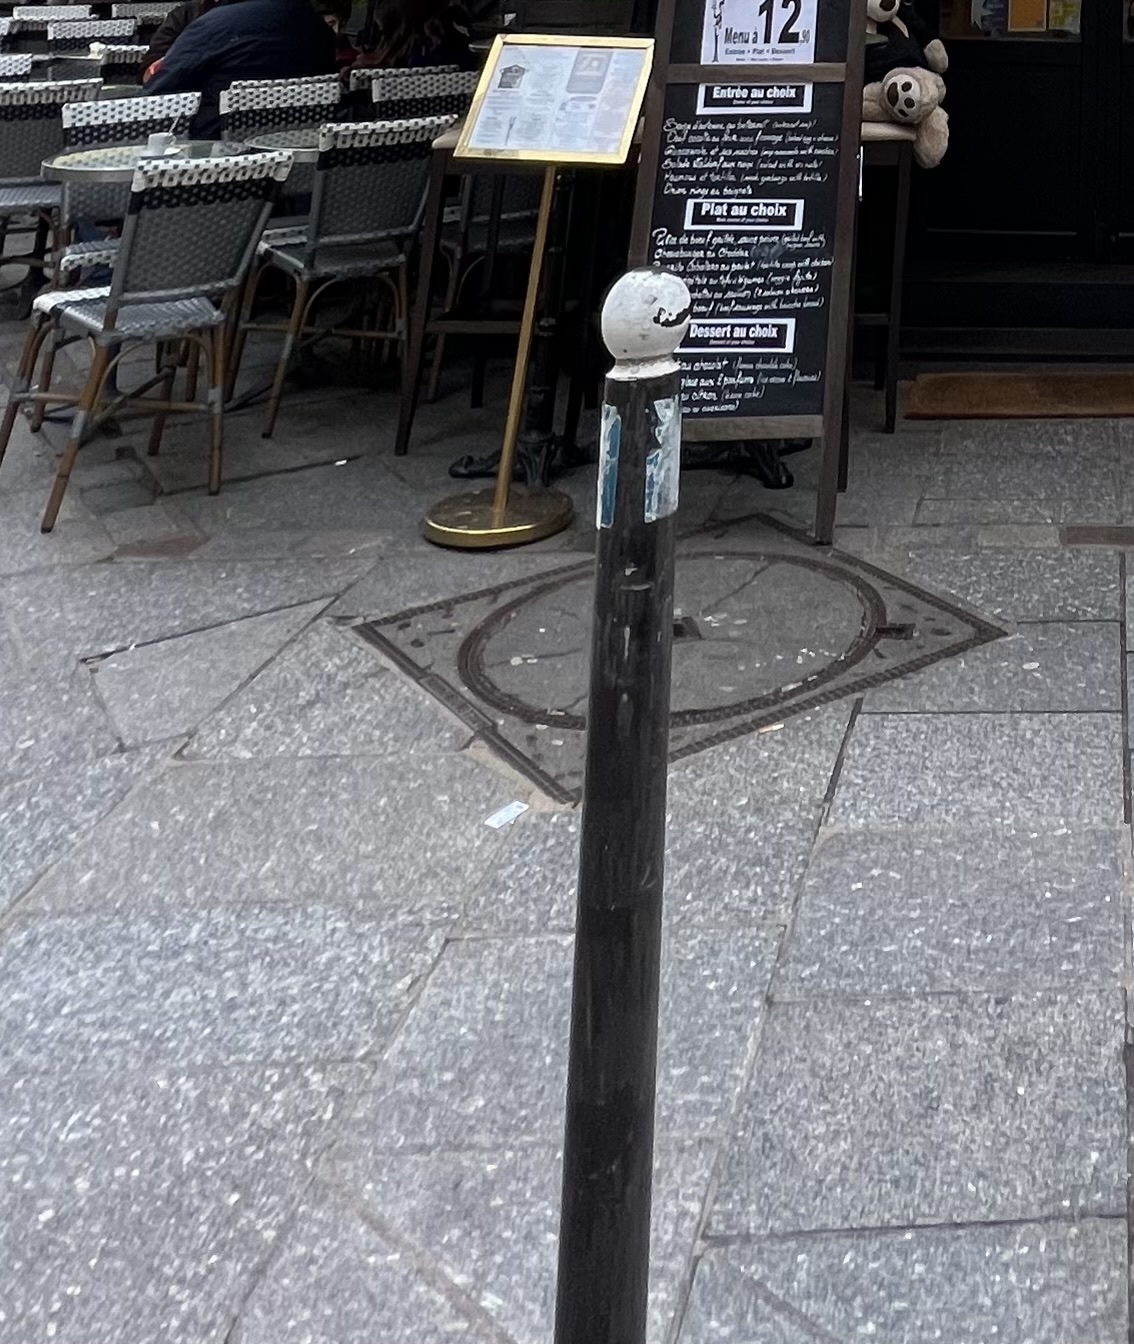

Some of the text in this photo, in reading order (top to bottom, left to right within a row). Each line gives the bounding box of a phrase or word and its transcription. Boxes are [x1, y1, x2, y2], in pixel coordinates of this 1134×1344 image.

[724, 27, 750, 44] Menu
[752, 26, 758, 44] à
[751, 86, 764, 98] au
[766, 85, 796, 98] choix
[701, 201, 786, 217] Plat au choix
[689, 324, 778, 338] Dessert au choix
